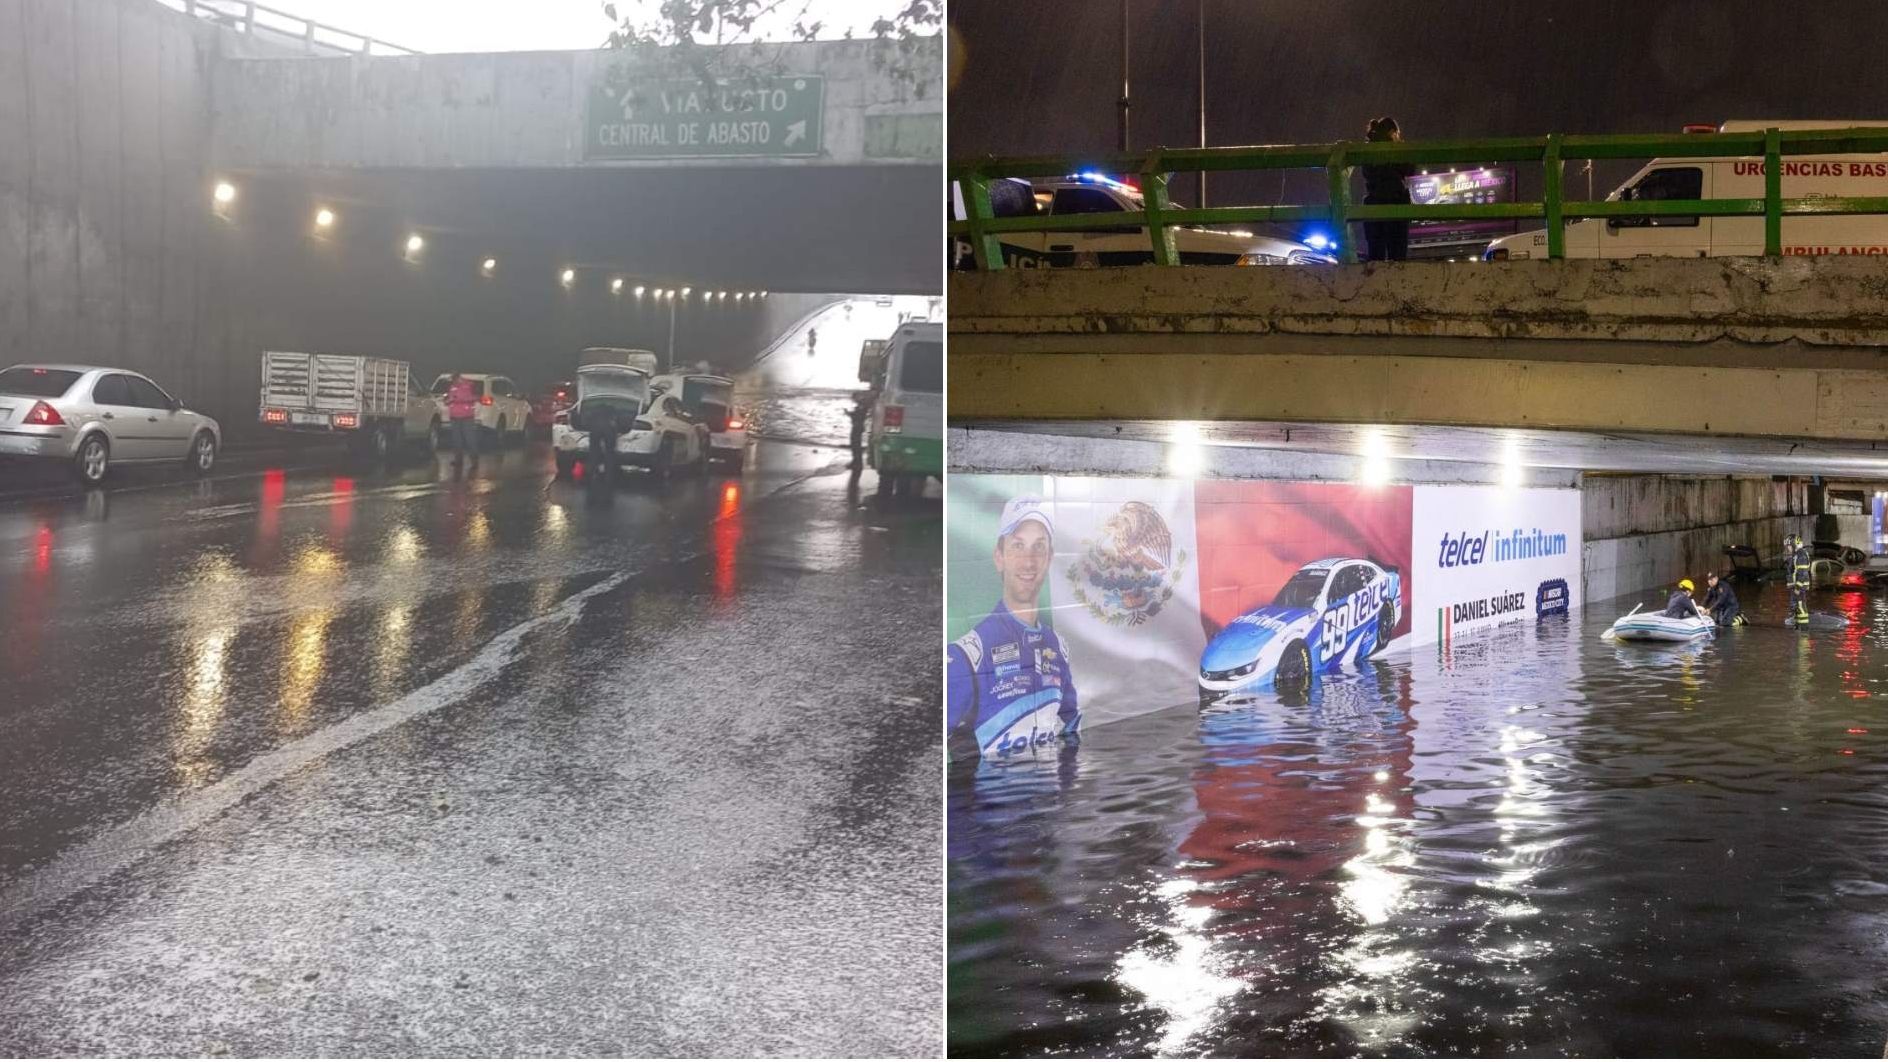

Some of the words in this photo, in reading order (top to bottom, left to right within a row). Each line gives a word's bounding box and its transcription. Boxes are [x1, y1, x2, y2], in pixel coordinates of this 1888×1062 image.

[661, 88, 788, 114] VIAUCTO
[600, 123, 669, 146] CENTRAL
[678, 123, 699, 145] DE
[707, 121, 770, 144] ABASTO
[1438, 530, 1489, 568] telcel
[1495, 528, 1567, 562] infinitum
[1453, 599, 1490, 624] DANIEL
[1491, 590, 1525, 616] SUÁREZ
[1320, 603, 1349, 663] 99
